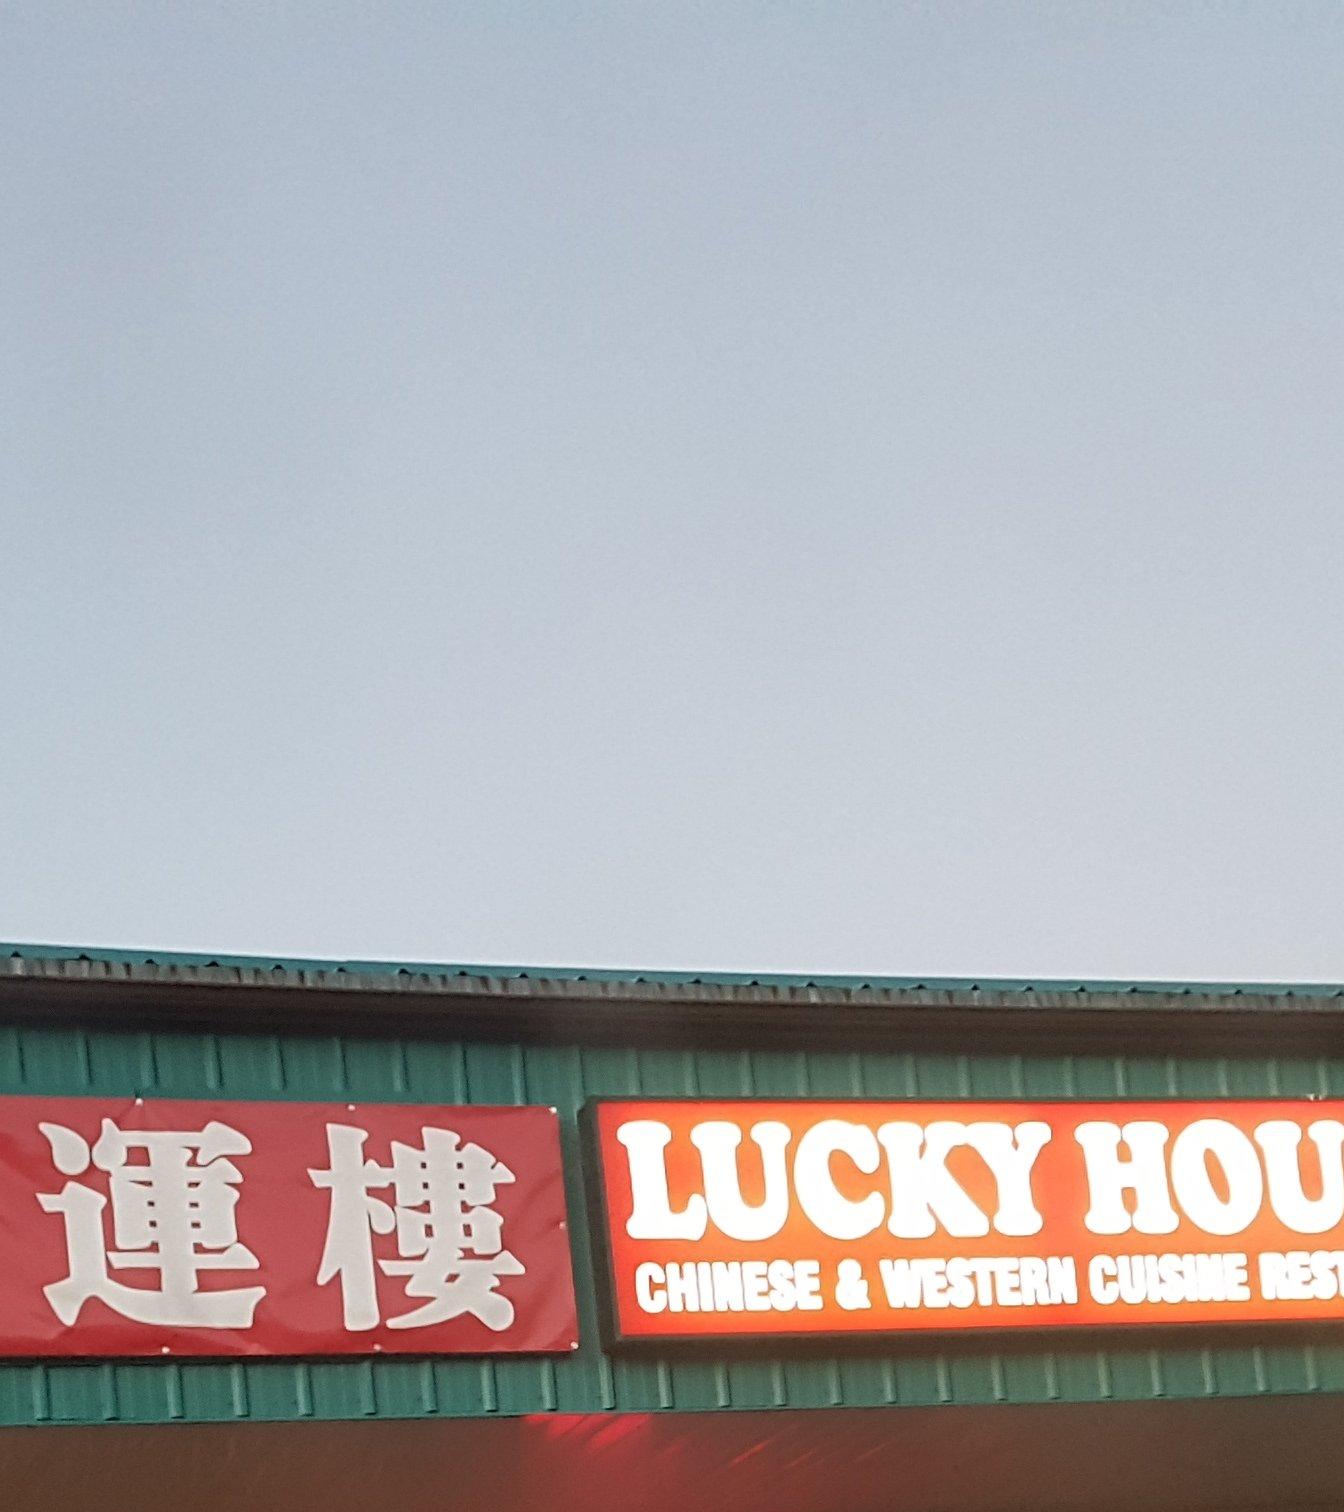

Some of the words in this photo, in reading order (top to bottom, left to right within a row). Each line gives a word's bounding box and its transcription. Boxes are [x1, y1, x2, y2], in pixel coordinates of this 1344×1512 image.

[617, 1120, 1052, 1241] LUCKY
[636, 1259, 823, 1313] CHINESE
[835, 1258, 872, 1310] &
[878, 1256, 1078, 1308] WESTERN
[1088, 1252, 1251, 1305] CUISINE
